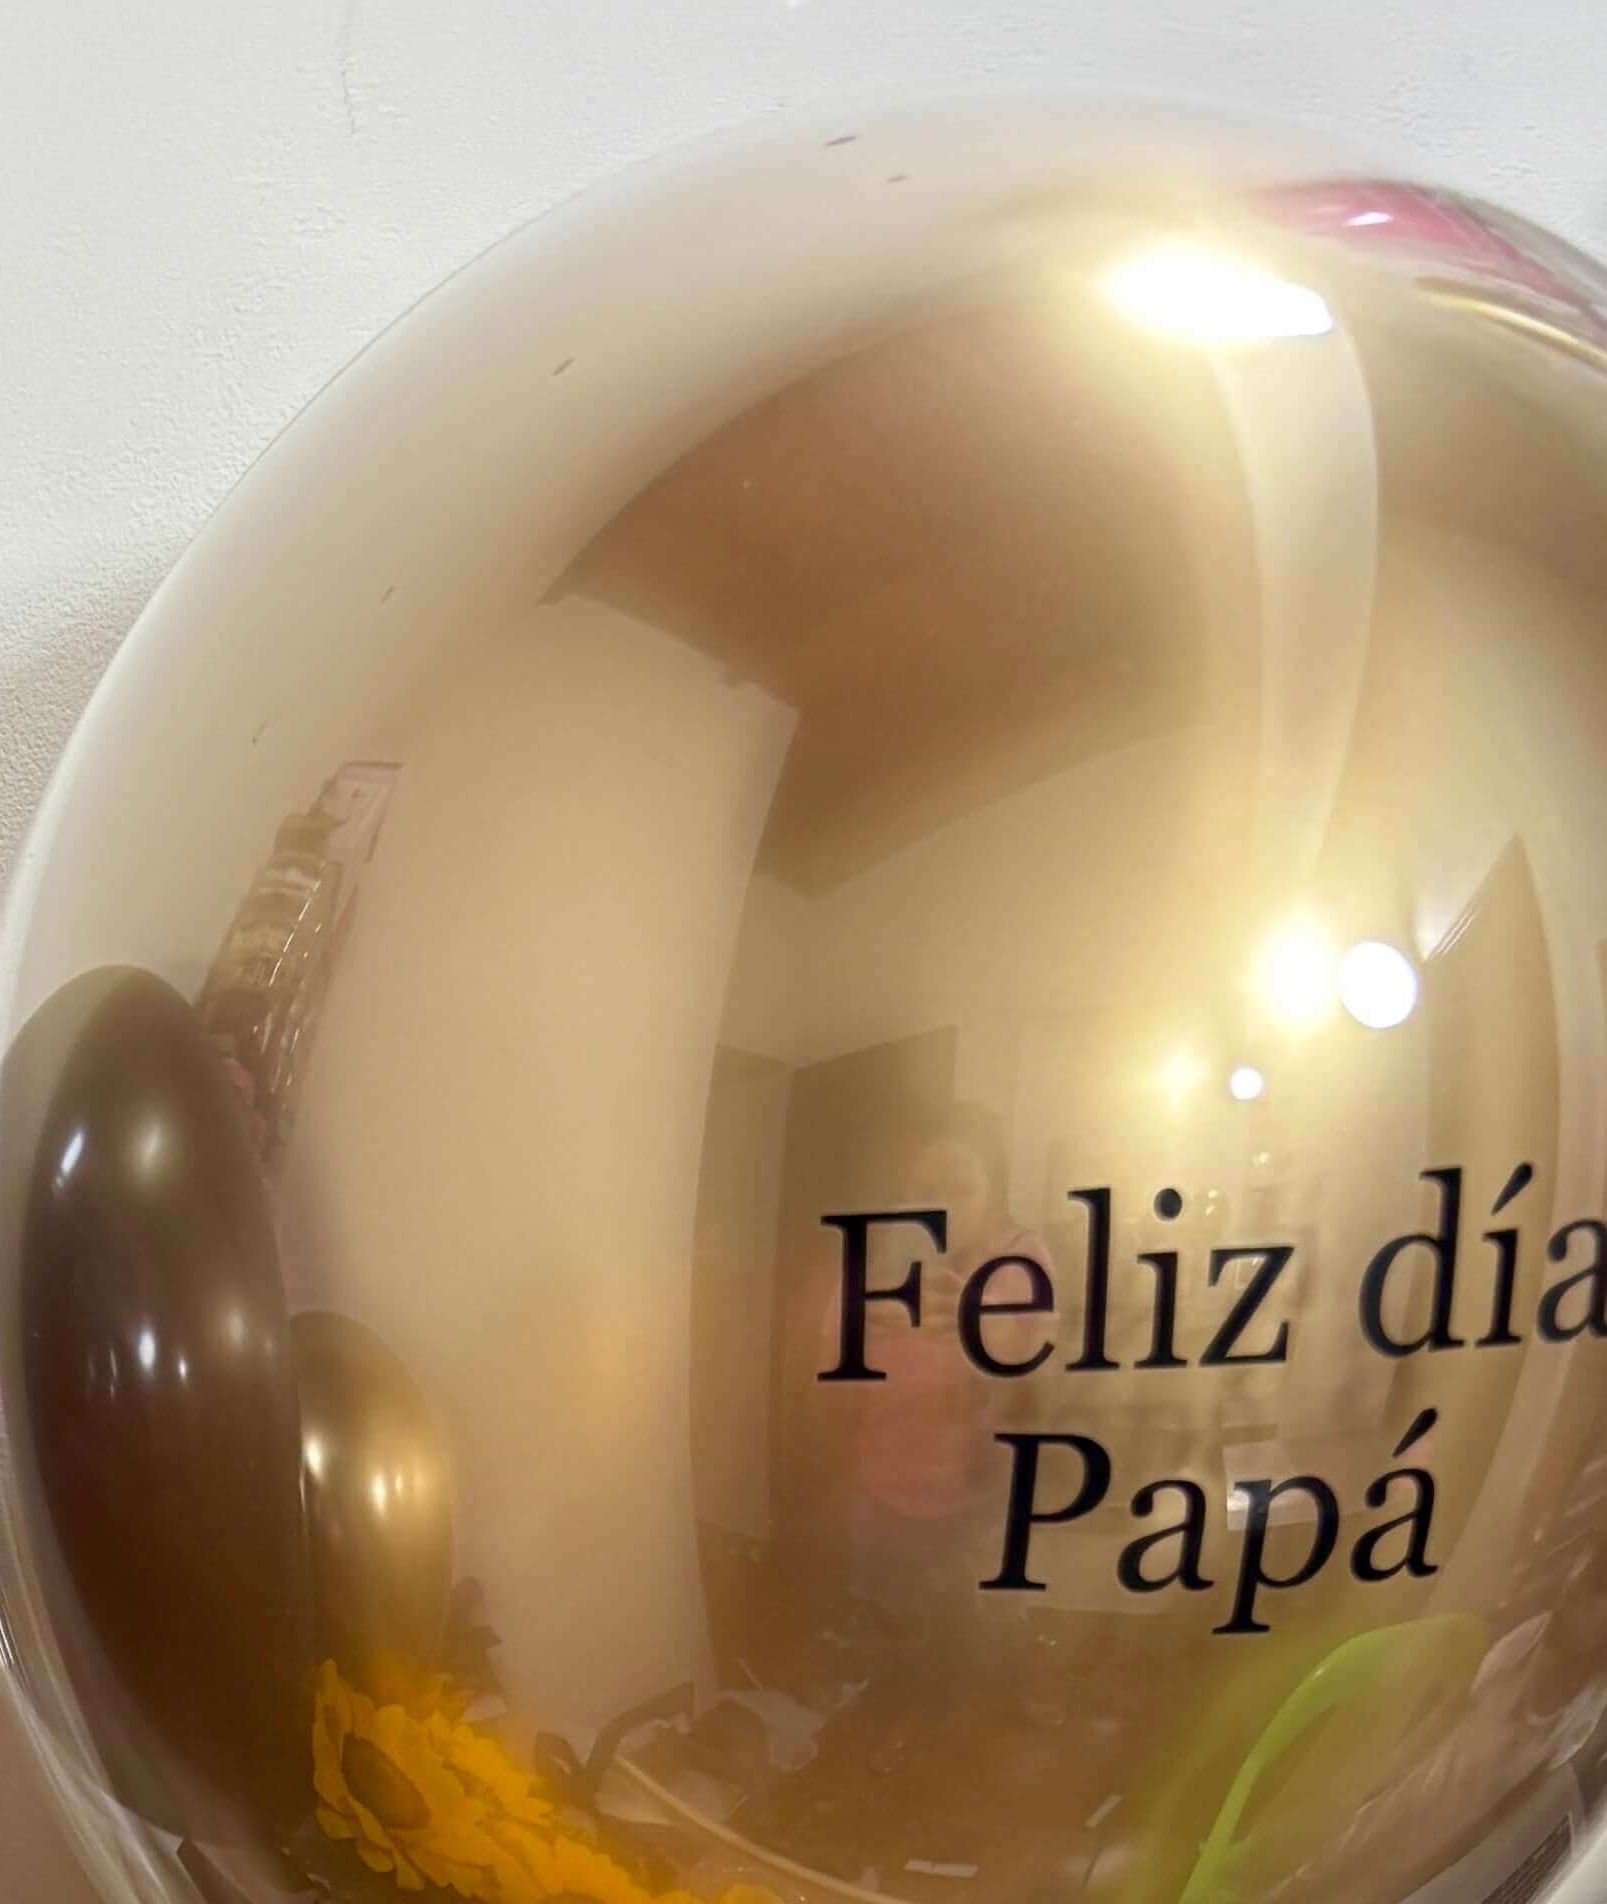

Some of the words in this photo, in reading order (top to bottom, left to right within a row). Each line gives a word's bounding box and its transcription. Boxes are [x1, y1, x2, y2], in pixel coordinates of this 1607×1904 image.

[817, 1186, 1296, 1382] Feliz
[1359, 1162, 1607, 1359] día
[978, 1407, 1440, 1635] Papá
